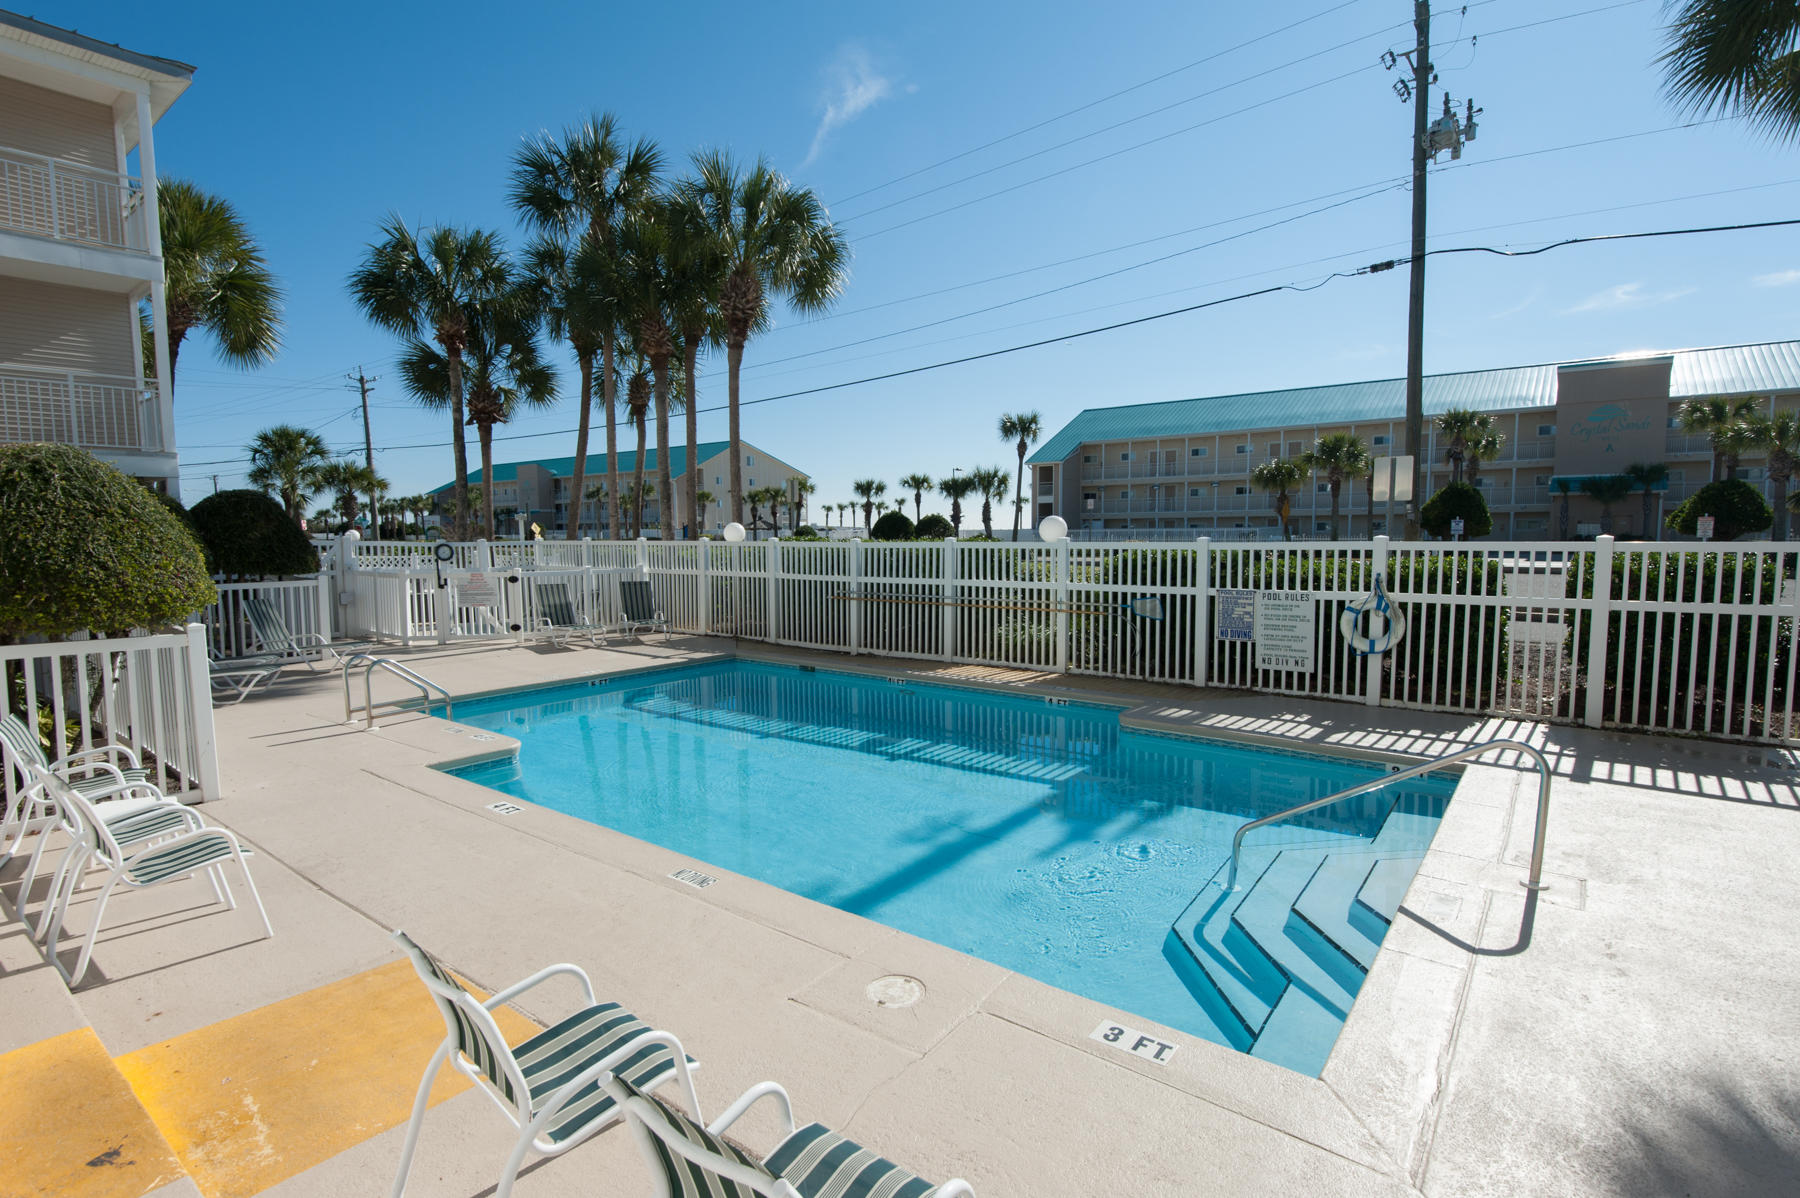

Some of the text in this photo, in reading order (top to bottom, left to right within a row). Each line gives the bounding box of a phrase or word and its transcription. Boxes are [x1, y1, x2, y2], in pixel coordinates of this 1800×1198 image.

[1262, 592, 1310, 602] POOL RULES
[1220, 628, 1229, 638] NO
[1230, 629, 1252, 640] DIVING
[1262, 656, 1272, 665] NO
[1275, 657, 1306, 668] DIVNG
[1103, 1026, 1174, 1062] 3 FT.
